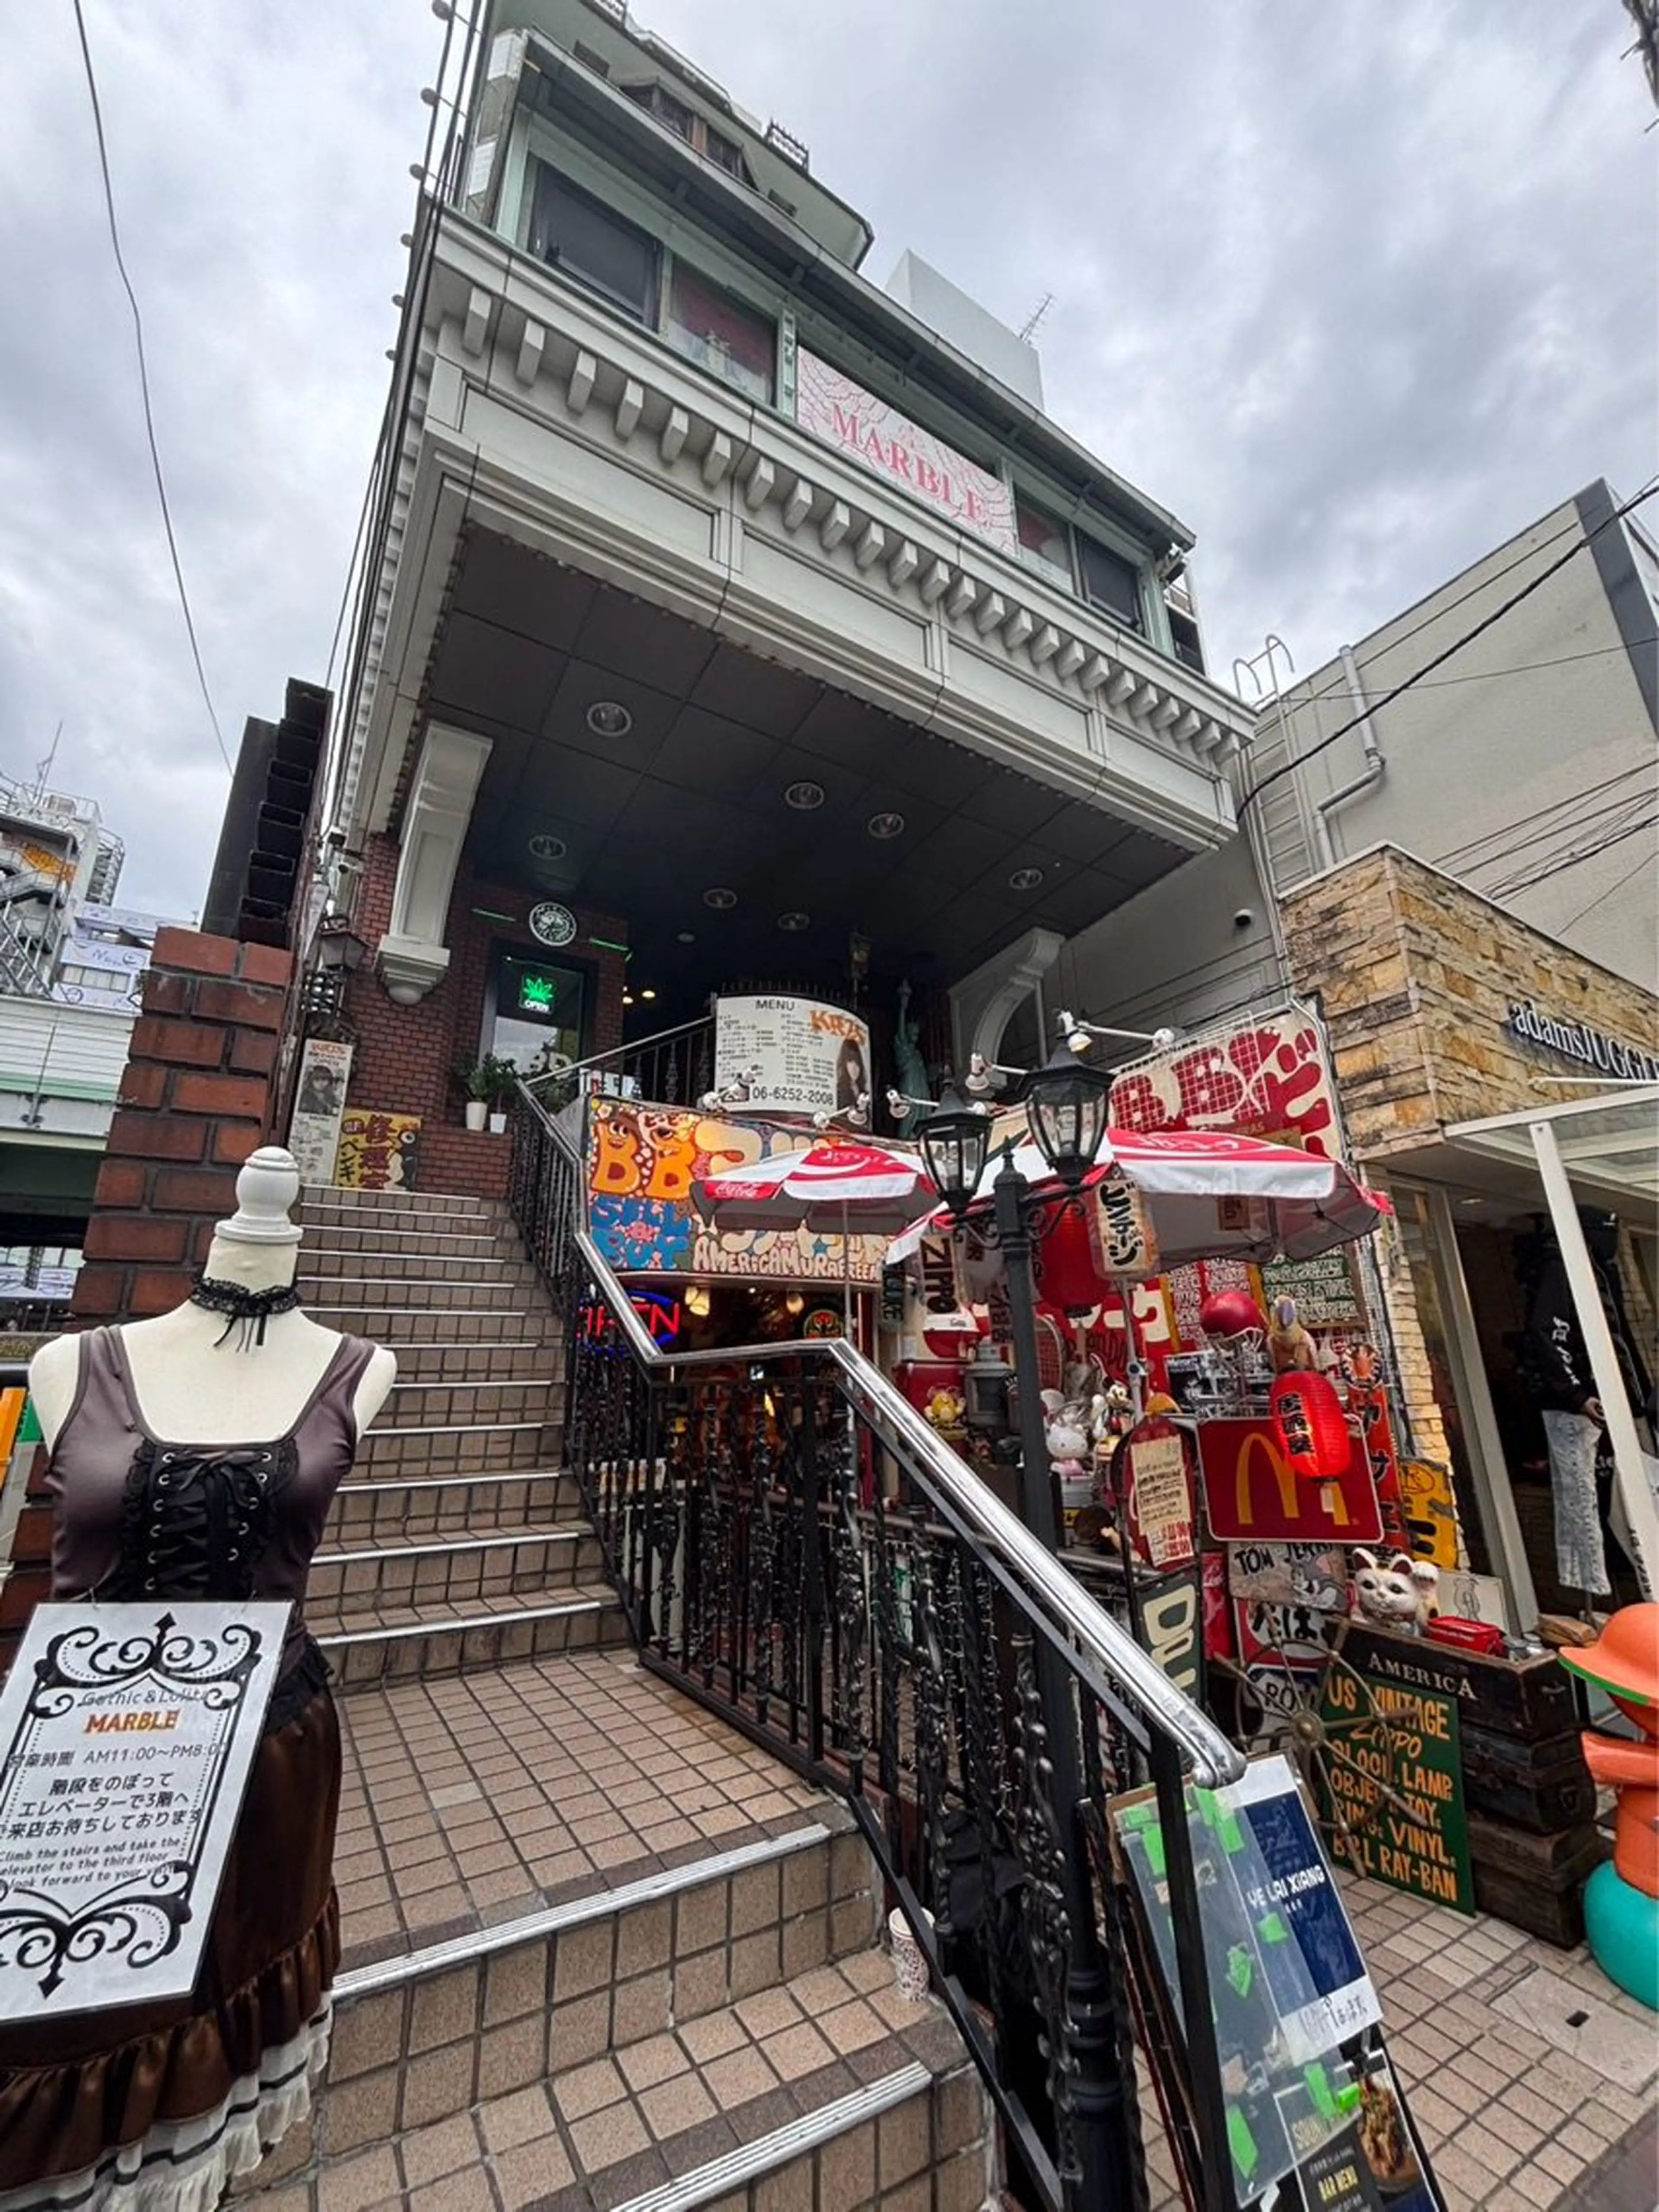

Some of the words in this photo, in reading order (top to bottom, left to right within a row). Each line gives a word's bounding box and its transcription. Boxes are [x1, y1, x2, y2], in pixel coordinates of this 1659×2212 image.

[832, 404, 985, 519] MARBLE
[755, 999, 795, 1011] MENU
[752, 1086, 834, 1106] 06-6252-2008
[1234, 1545, 1275, 1576] TOM
[1369, 1652, 1478, 1700] AMERICA
[1328, 1675, 1357, 1712] US
[85, 1709, 180, 1734] MARBLE
[49, 1772, 173, 1796] 階段をのぼって
[18, 1791, 189, 1818] エレベーターで3階へ
[38, 1848, 58, 1858] the
[63, 1844, 99, 1856] stairs
[103, 1840, 127, 1852] and
[130, 1839, 156, 1850] take
[161, 1837, 181, 1847] the
[60, 1861, 73, 1871] to
[78, 1858, 99, 1869] the
[103, 1853, 135, 1866] third
[139, 1852, 169, 1863] floor
[1380, 1845, 1458, 1902] RAY-BAN
[42, 1871, 94, 1886] forward
[98, 1871, 111, 1881] to
[115, 1869, 141, 1881] your
[1265, 1879, 1290, 1902] LAI
[1287, 1865, 1325, 1894] XIANG
